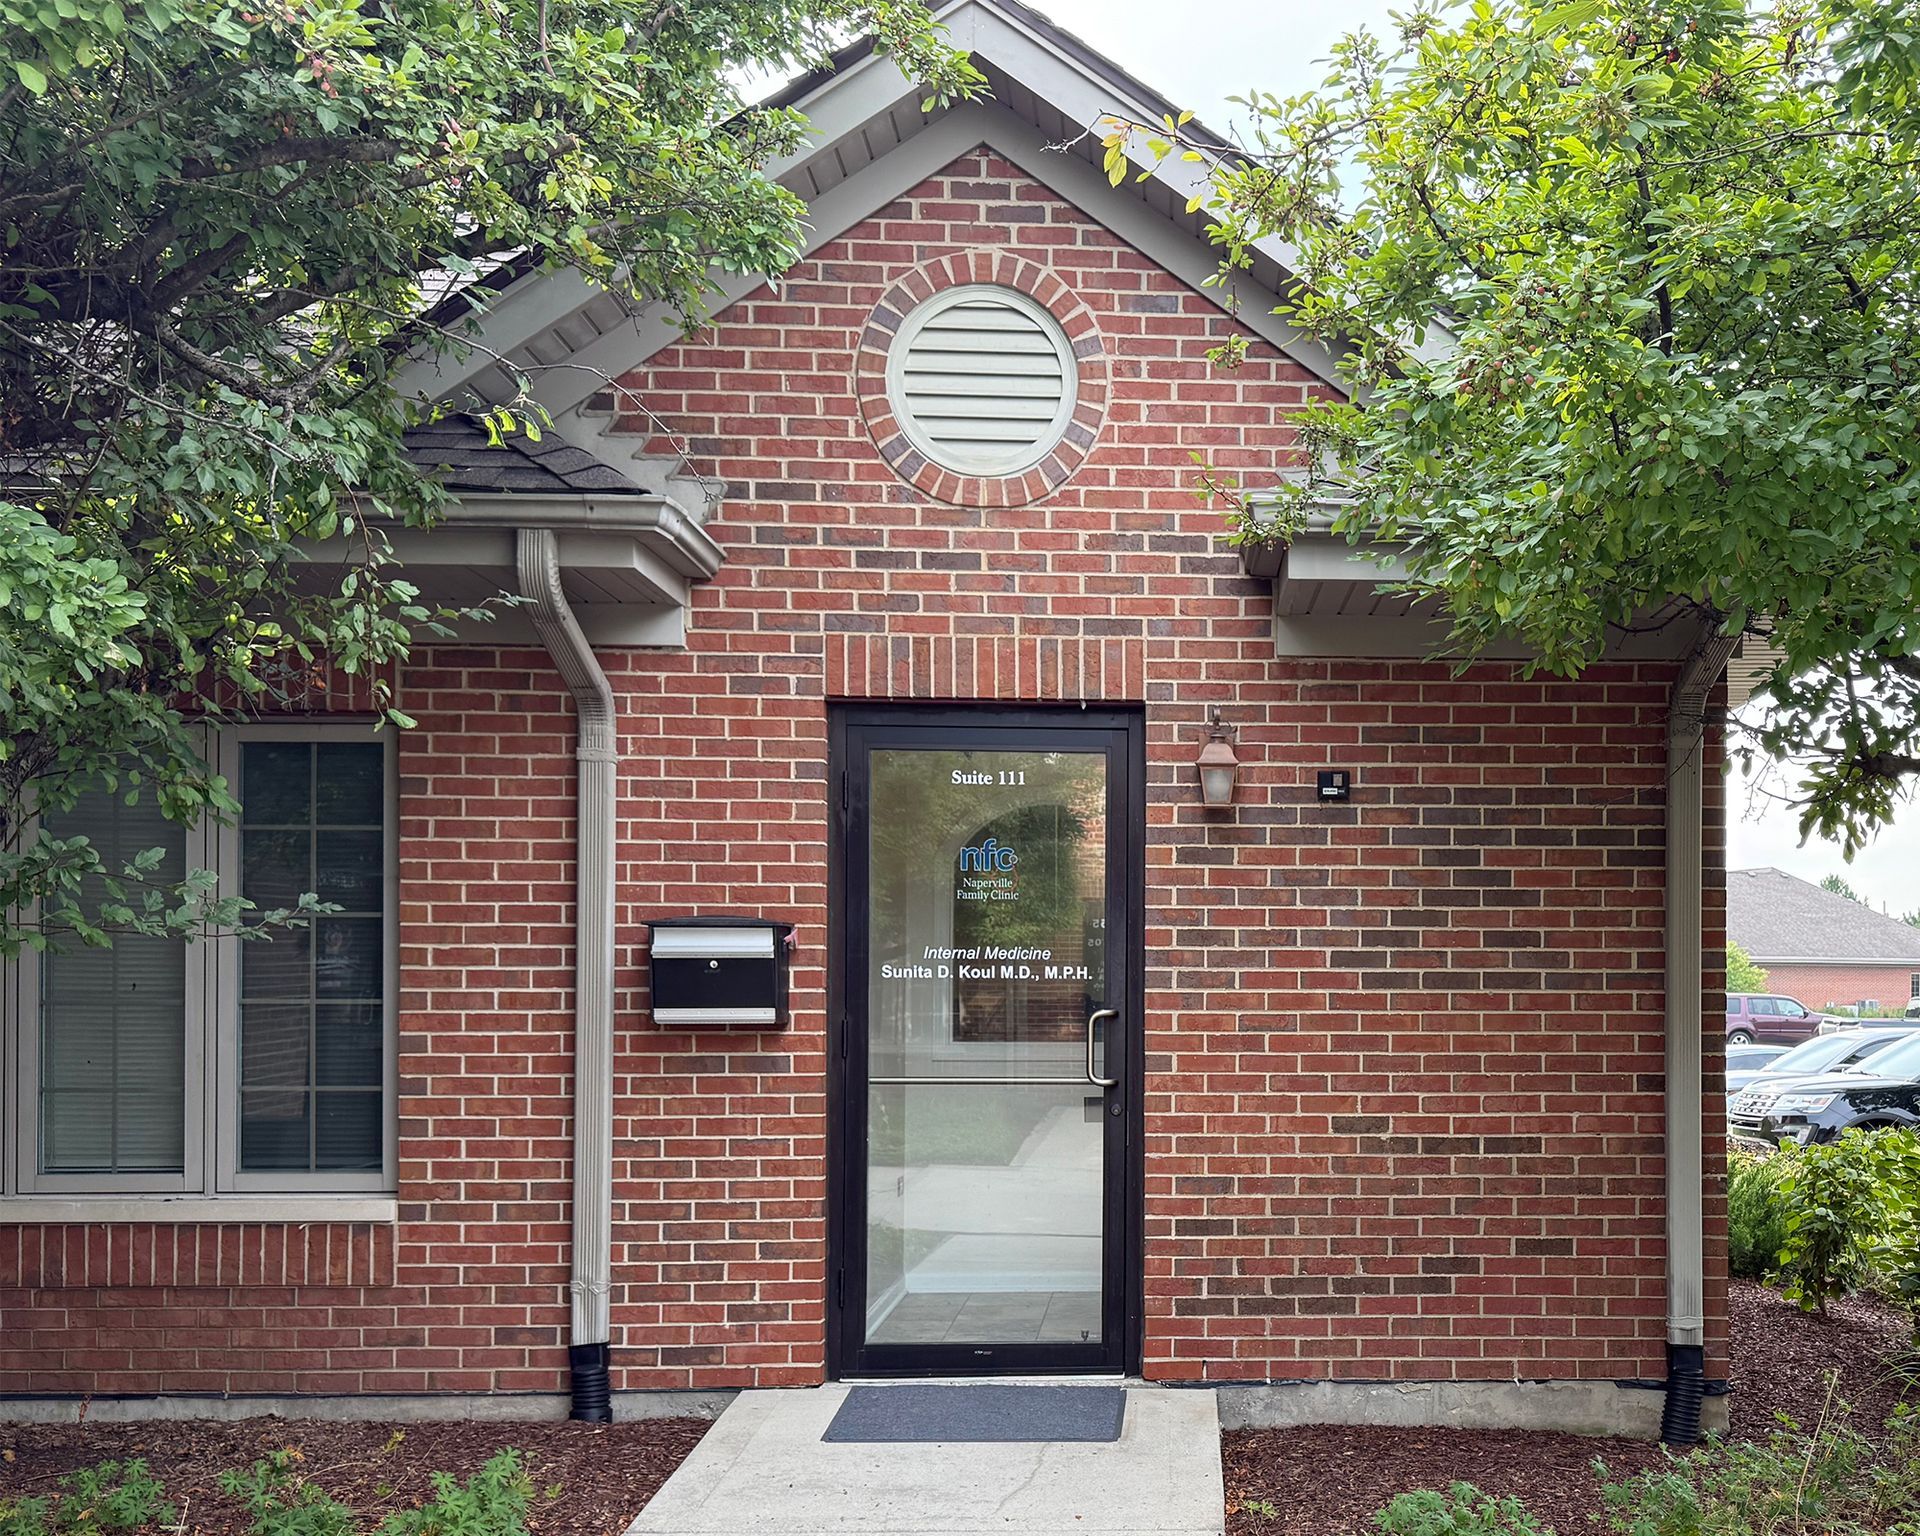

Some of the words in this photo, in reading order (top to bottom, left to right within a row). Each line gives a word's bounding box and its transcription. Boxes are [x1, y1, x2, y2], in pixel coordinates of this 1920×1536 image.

[951, 769, 993, 785] Suite
[998, 770, 1025, 785] 111
[960, 838, 1014, 872] nfc
[963, 877, 1013, 890] Naperville
[957, 889, 989, 902] Family
[990, 889, 1019, 900] Clinic
[923, 945, 980, 960] Internal
[984, 946, 1051, 960] Medicine
[881, 964, 933, 979] Sunita
[937, 965, 954, 979] D.
[959, 965, 996, 979] Koul
[1000, 965, 1040, 982] M.D.,
[1044, 966, 1093, 980] M.P.H.
